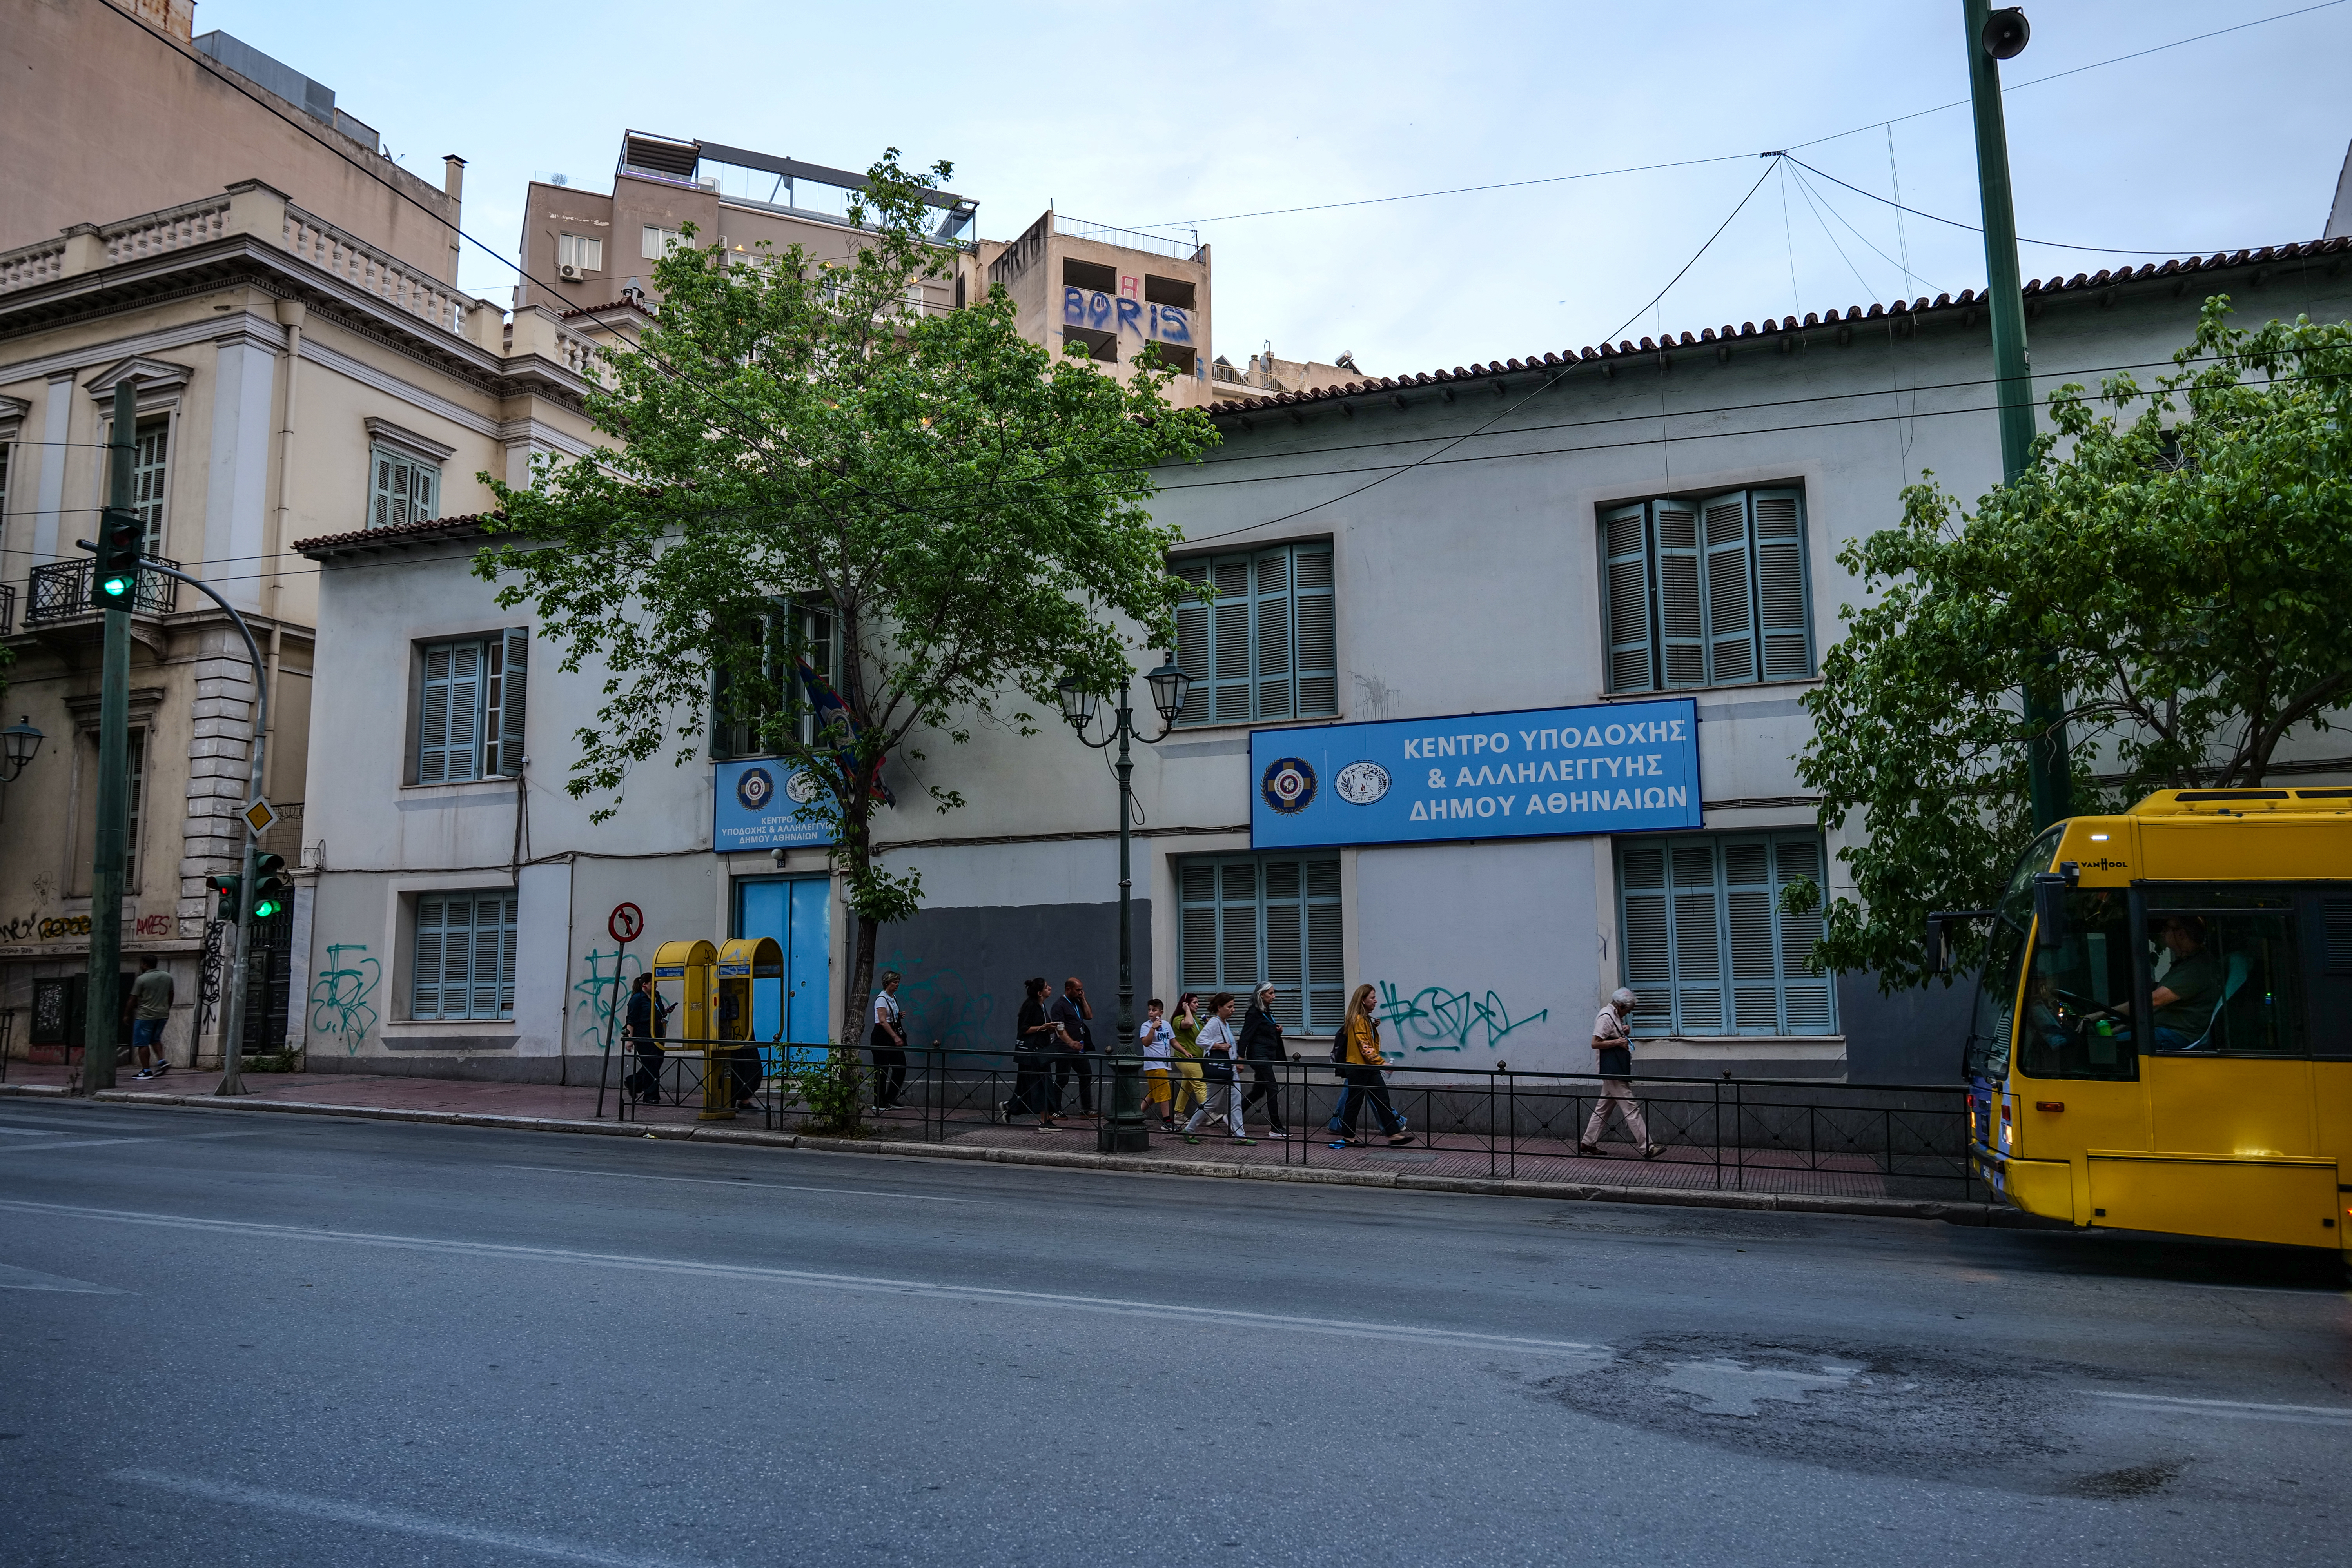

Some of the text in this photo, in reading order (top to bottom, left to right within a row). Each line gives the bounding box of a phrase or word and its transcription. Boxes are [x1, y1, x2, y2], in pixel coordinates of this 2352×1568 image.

[1063, 287, 1193, 343] BORIS
[1404, 720, 1686, 759] ΚΕΝΤΡΟ ΥΠΟΔΟΧΗΣ
[1428, 754, 1663, 788] & ΑΛΛΗΛΕΓΓΥΗΣ
[761, 816, 793, 825] ΚΕΝΤΡΟ
[1409, 786, 1687, 821] ΔΗΜΟΥ ΑΘΗΝΑΙΩΝ
[722, 826, 767, 836] ΥΠΟΔΟΧΗΣ
[739, 832, 818, 844] ΔΗΜΟΥ ΑΘΗΝΑΙΩΝ
